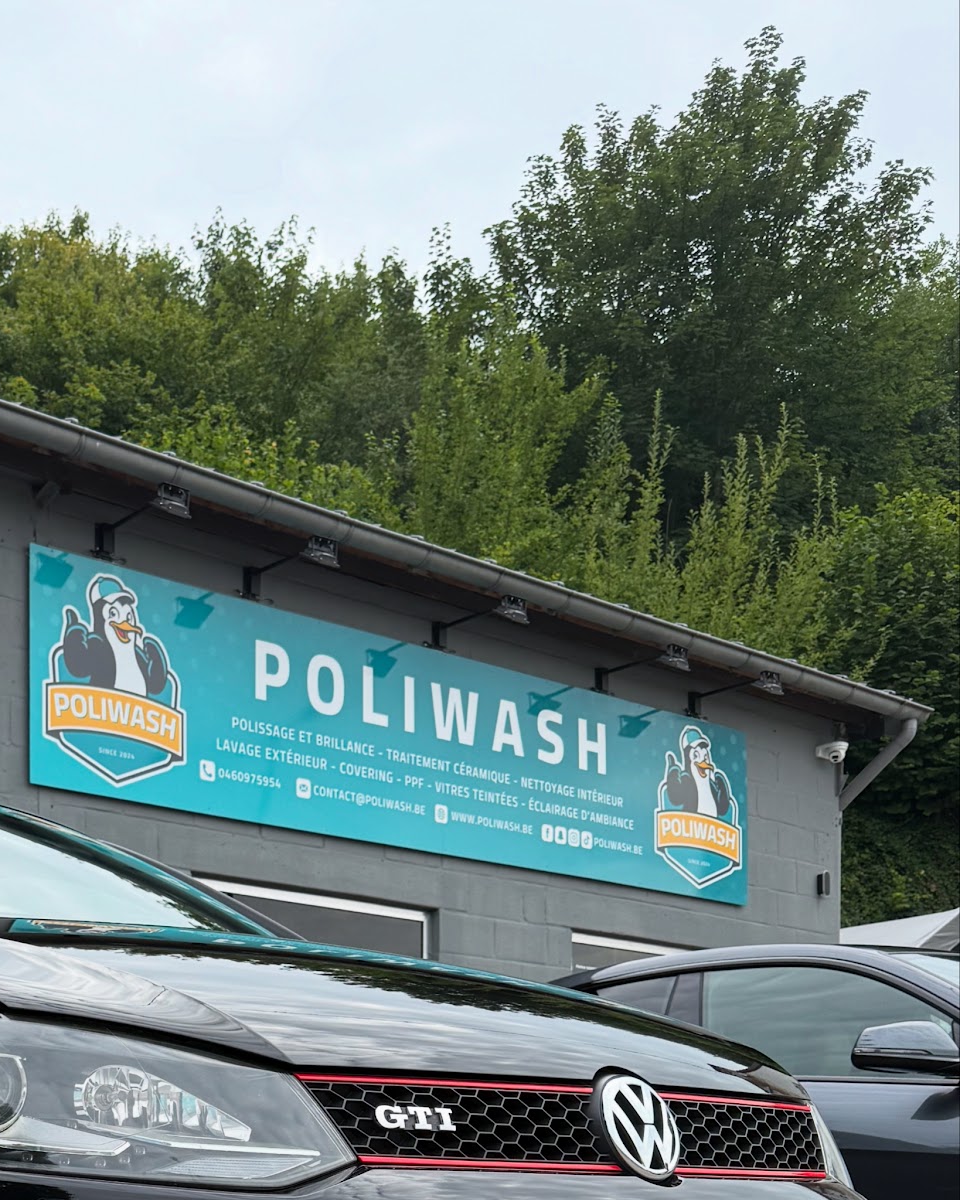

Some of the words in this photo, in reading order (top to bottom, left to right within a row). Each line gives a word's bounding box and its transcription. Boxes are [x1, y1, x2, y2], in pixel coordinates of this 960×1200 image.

[54, 693, 176, 741] POLIWASH
[255, 639, 607, 775] POLIWASH
[98, 747, 117, 758] SINCE
[231, 716, 295, 741] POLISSAGE
[299, 730, 313, 744] ET
[316, 734, 375, 757] BRILLANCE
[386, 748, 450, 772] TRAITEMENT
[453, 760, 511, 785] CÉRAMIQUE
[520, 776, 575, 798] NETTOYAGE
[577, 788, 624, 808] INTÉRIEUR
[216, 737, 261, 758] LAVAGE
[265, 747, 327, 771] EXTÉRIEUR
[339, 762, 393, 784] COVERING
[404, 775, 424, 789] PPF
[434, 781, 470, 798] VITRES
[472, 788, 518, 808] TEINTÉES
[528, 797, 578, 819] ÉCLAIRAGE
[581, 809, 634, 831] D'AMBIANCE
[218, 768, 281, 790] 0460975954
[313, 785, 426, 816] CONTACT@POLIWASH.BE
[451, 811, 533, 835] WWW.POLIWASH.BE
[661, 818, 737, 850] POLIWASH
[593, 837, 643, 856] POLIWASH.BE
[375, 1105, 457, 1132] GTI
